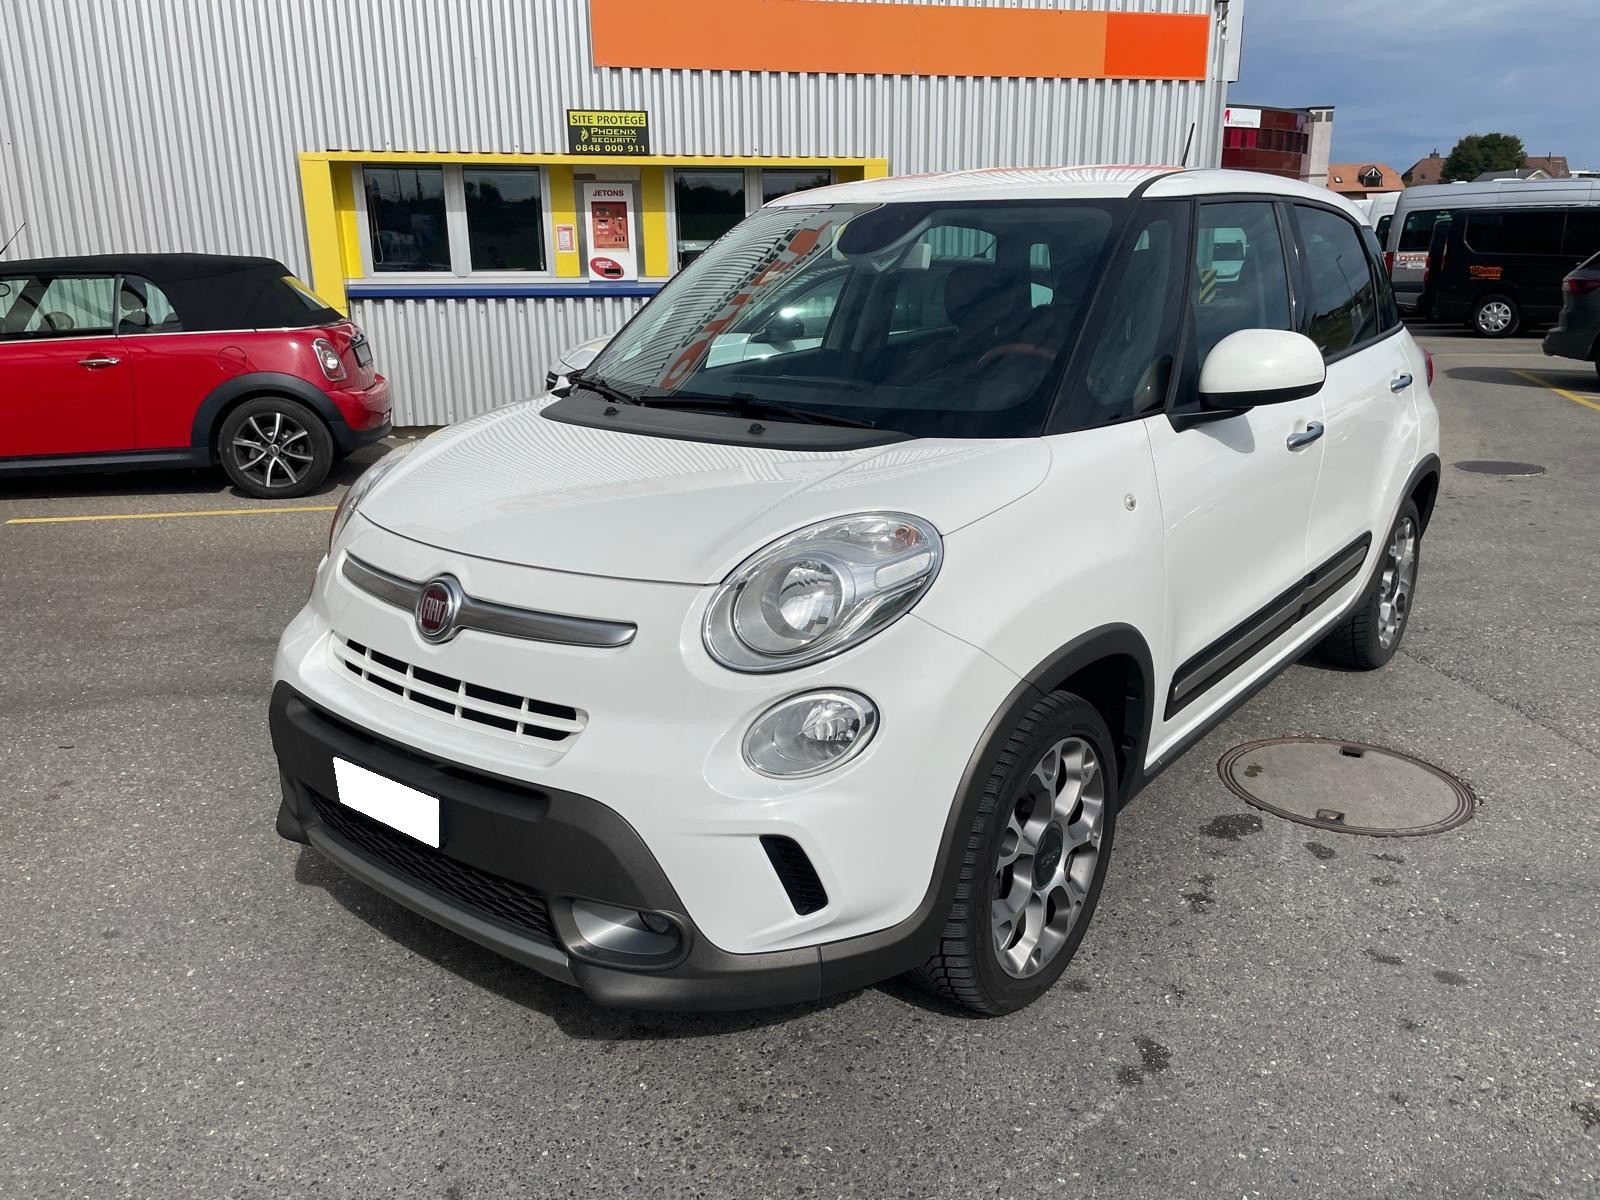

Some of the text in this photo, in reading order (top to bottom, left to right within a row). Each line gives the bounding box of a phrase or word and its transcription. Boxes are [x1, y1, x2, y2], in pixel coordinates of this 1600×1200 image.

[571, 112, 645, 125] SITE PROTÉGÉ
[575, 144, 645, 153] 0848 000 911
[592, 189, 625, 197] JETONS
[422, 596, 446, 624] FIAT
